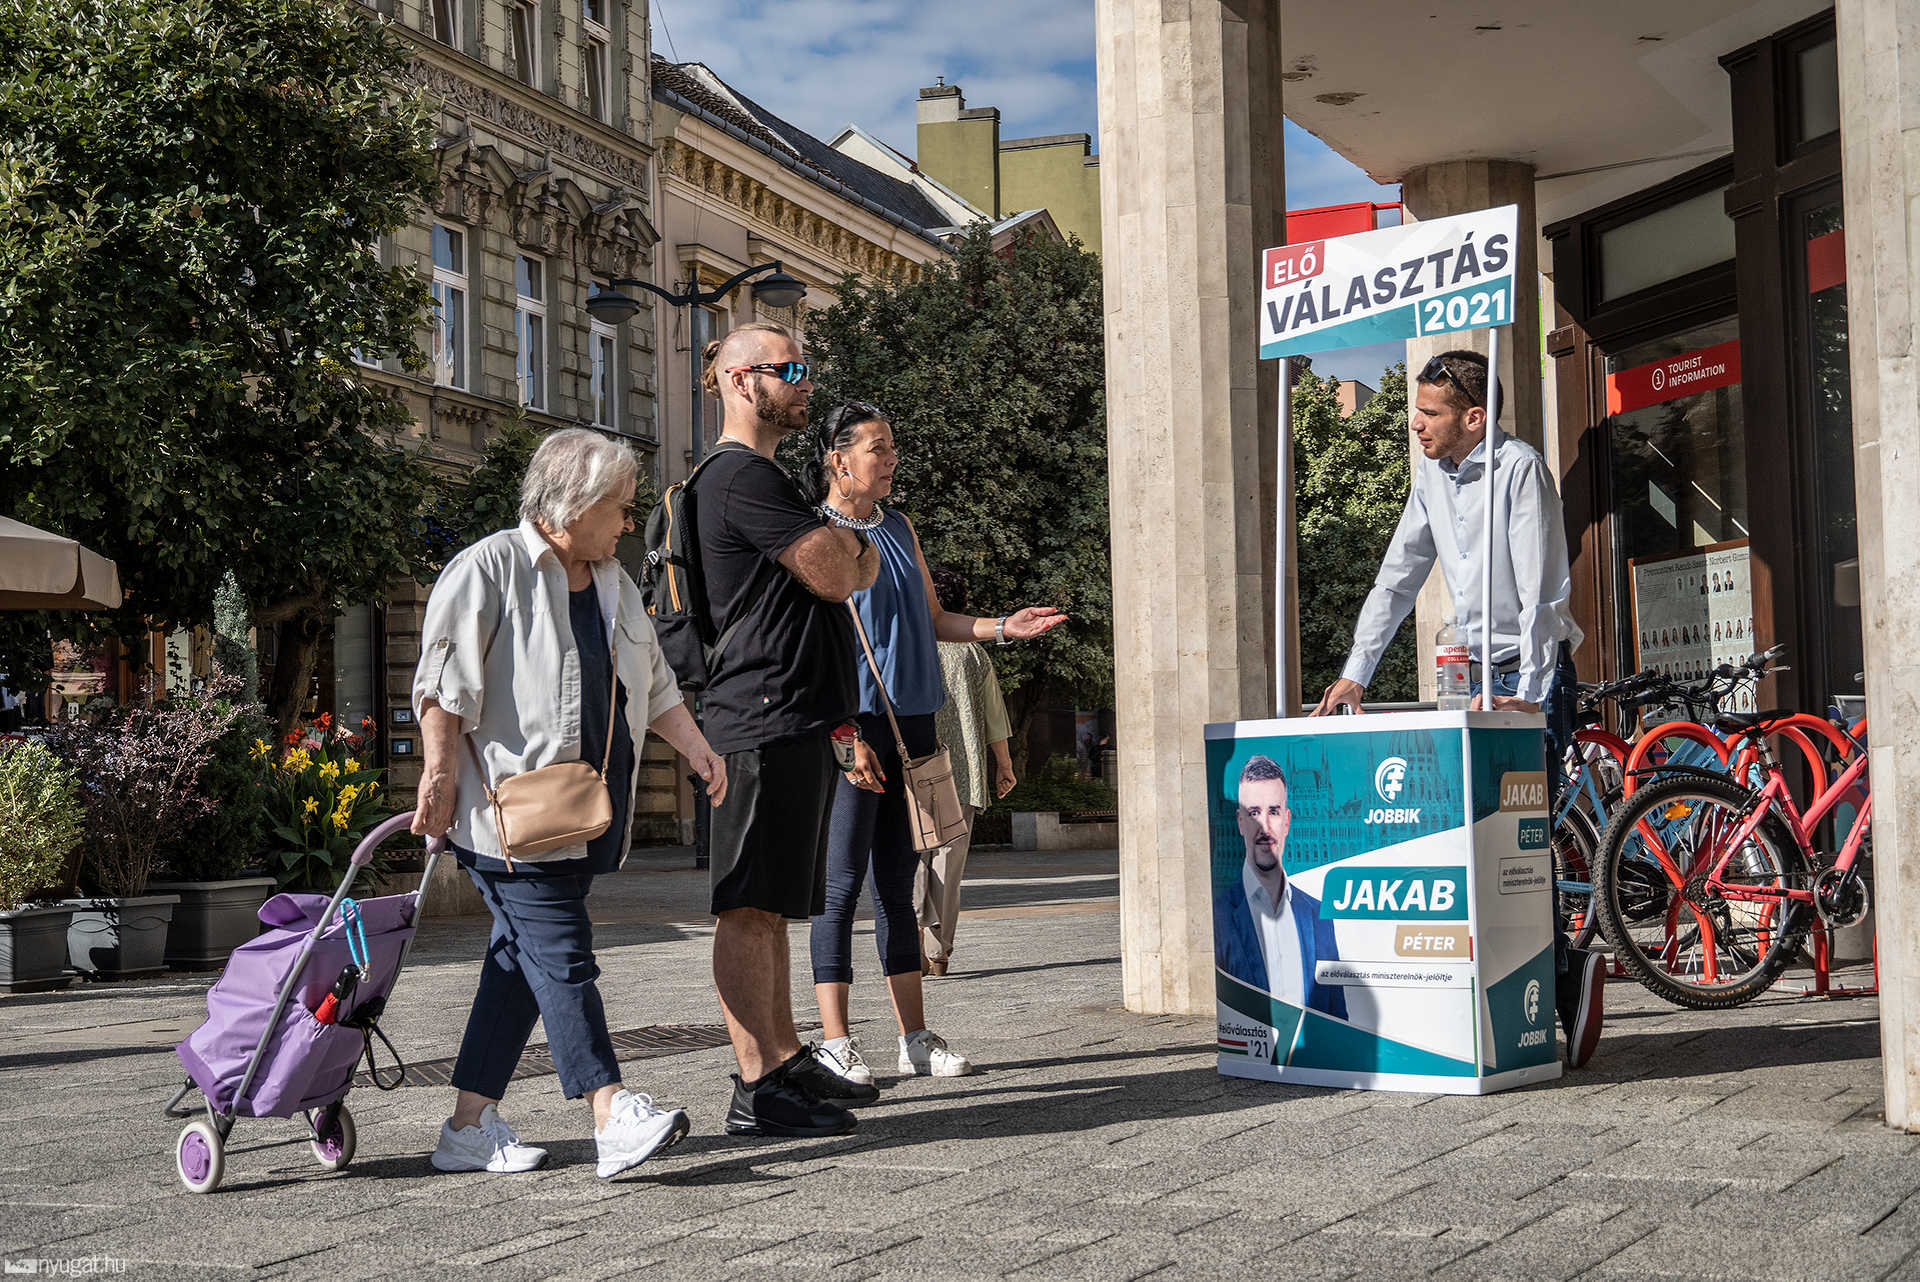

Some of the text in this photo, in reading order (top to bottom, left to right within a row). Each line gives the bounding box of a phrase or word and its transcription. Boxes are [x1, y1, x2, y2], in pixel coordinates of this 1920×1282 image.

[1273, 246, 1317, 285] ELŐ
[1266, 231, 1509, 335] VÁLASZTÁS
[1424, 289, 1506, 332] 2021
[1668, 356, 1702, 374] TOURIST
[1669, 363, 1725, 387] INFORMATION
[1502, 783, 1544, 806] JAKAB
[1364, 808, 1421, 825] JOBBIK
[1520, 824, 1543, 843] PÉTER
[1333, 879, 1456, 911] JAKAB
[1402, 933, 1456, 951] PÉTER
[1330, 969, 1370, 979] előválasztás
[1518, 1028, 1547, 1048] JOBBIK
